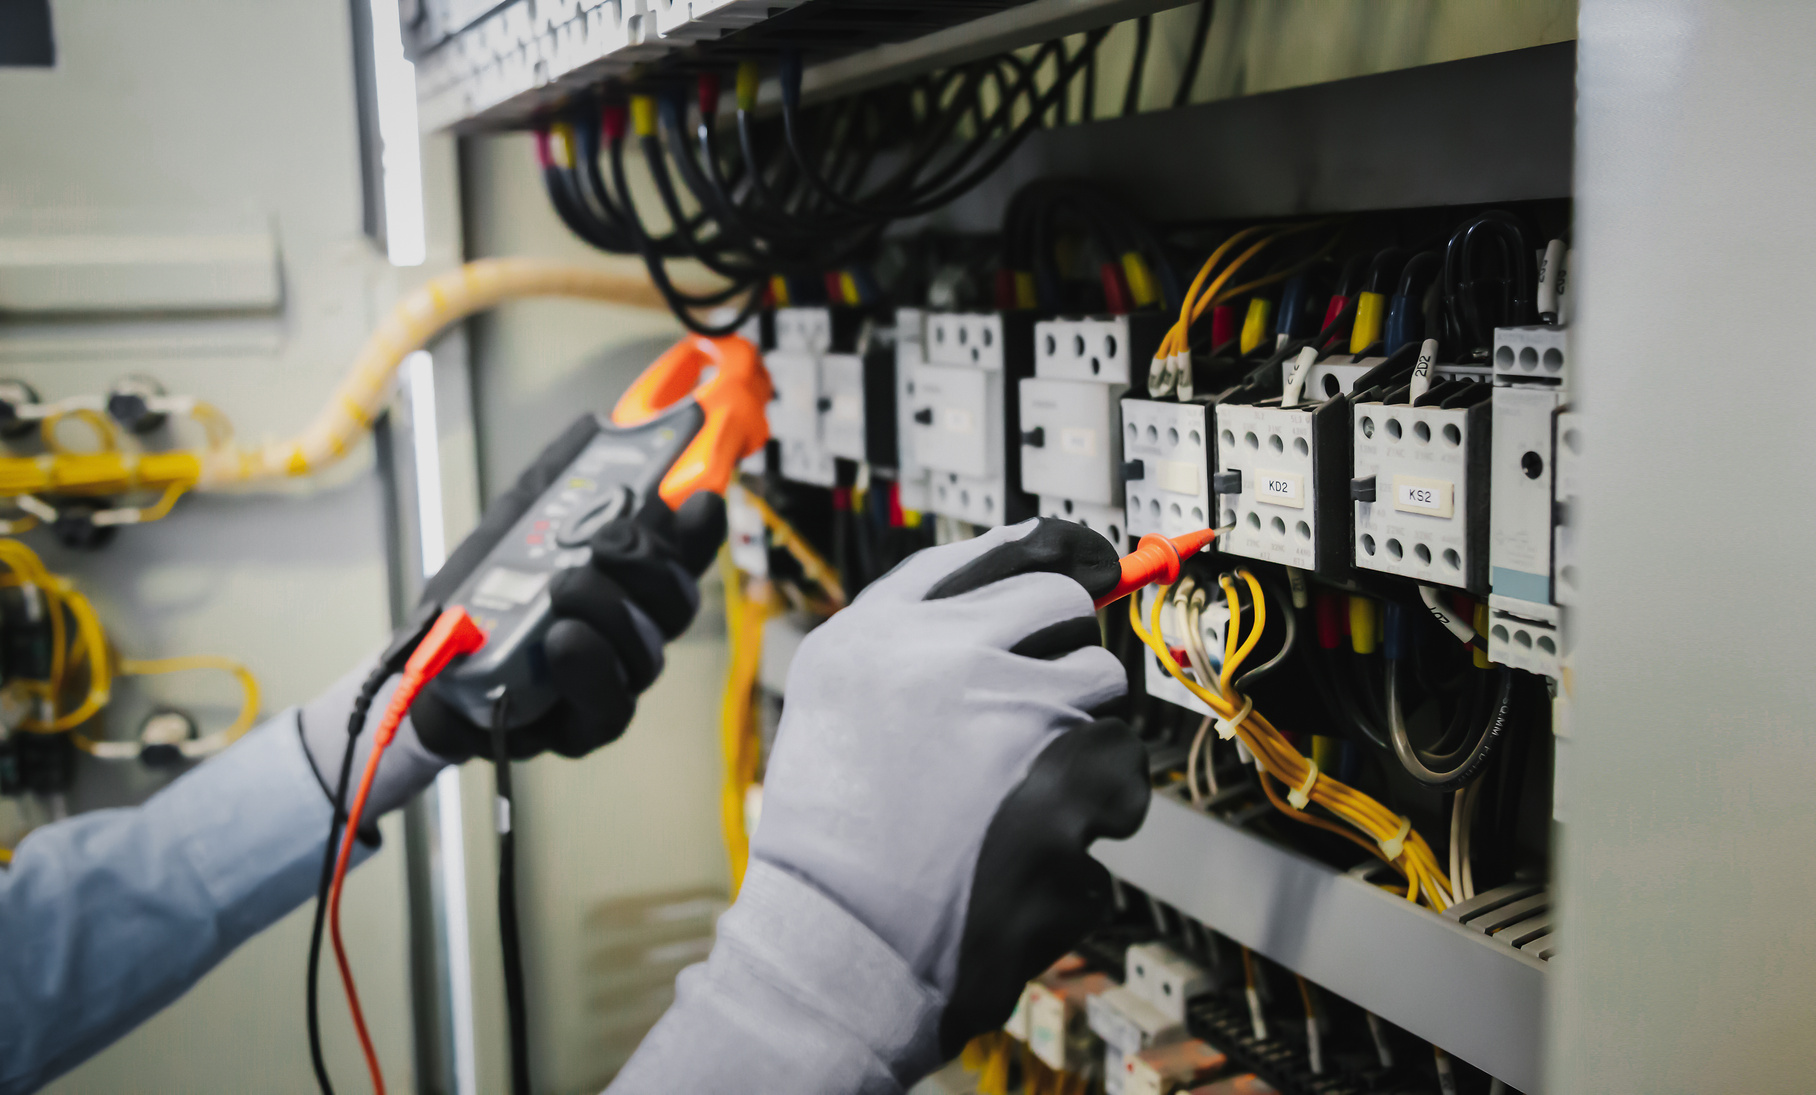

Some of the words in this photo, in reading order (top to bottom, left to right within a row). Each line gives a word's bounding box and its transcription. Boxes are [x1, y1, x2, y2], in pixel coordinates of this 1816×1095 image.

[1414, 355, 1431, 377] 2D2
[1268, 479, 1289, 493] KD2
[1409, 488, 1432, 504] KS2
